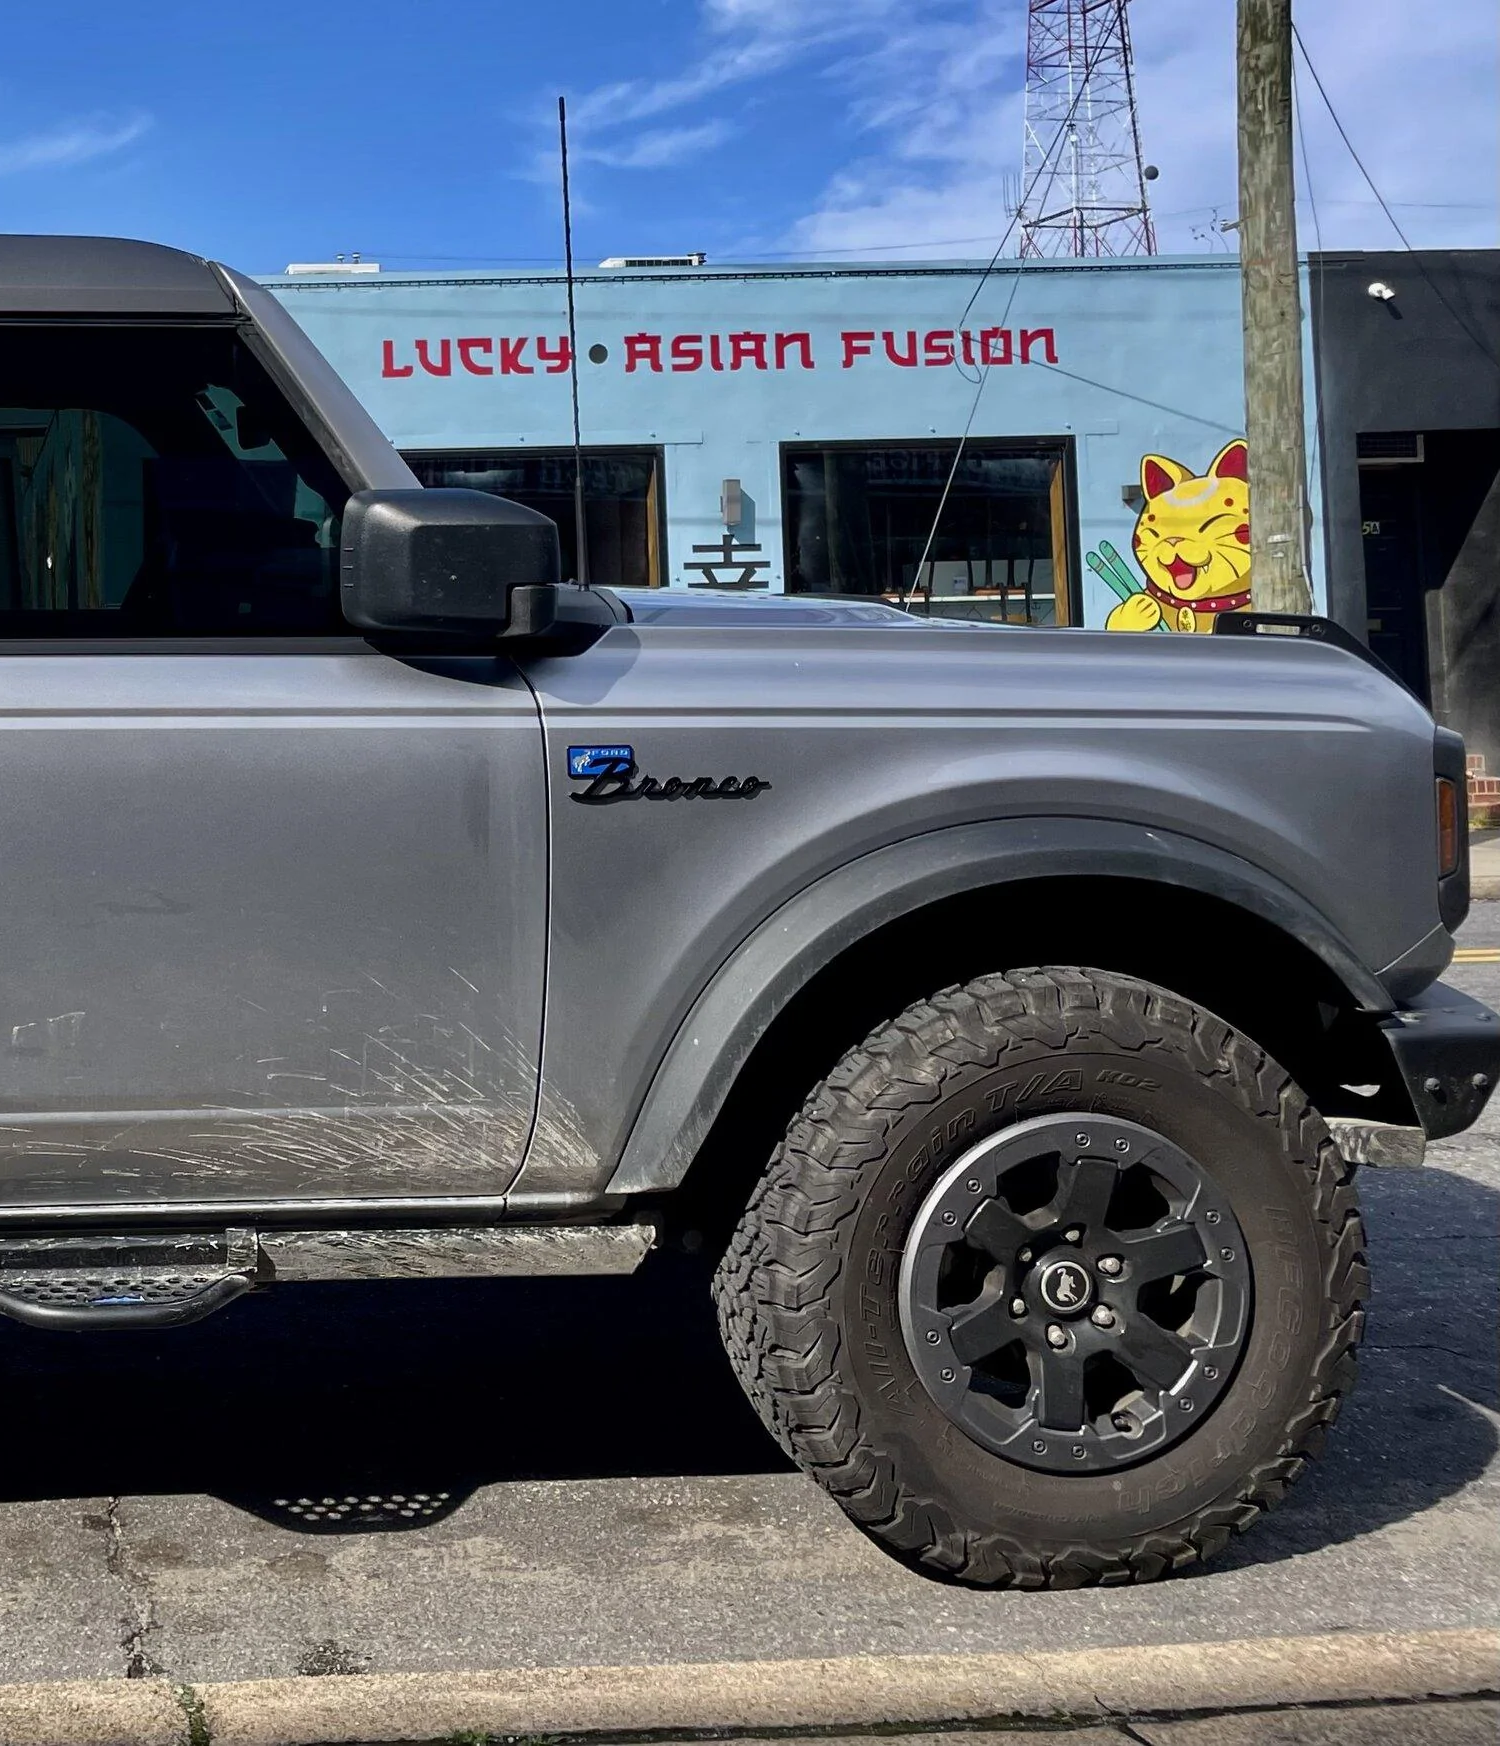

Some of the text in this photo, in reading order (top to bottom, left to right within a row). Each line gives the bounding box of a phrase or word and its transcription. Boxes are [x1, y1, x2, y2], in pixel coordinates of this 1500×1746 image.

[382, 327, 1059, 379] LUCKY ASIAN FUSION
[569, 758, 773, 806] Bronco
